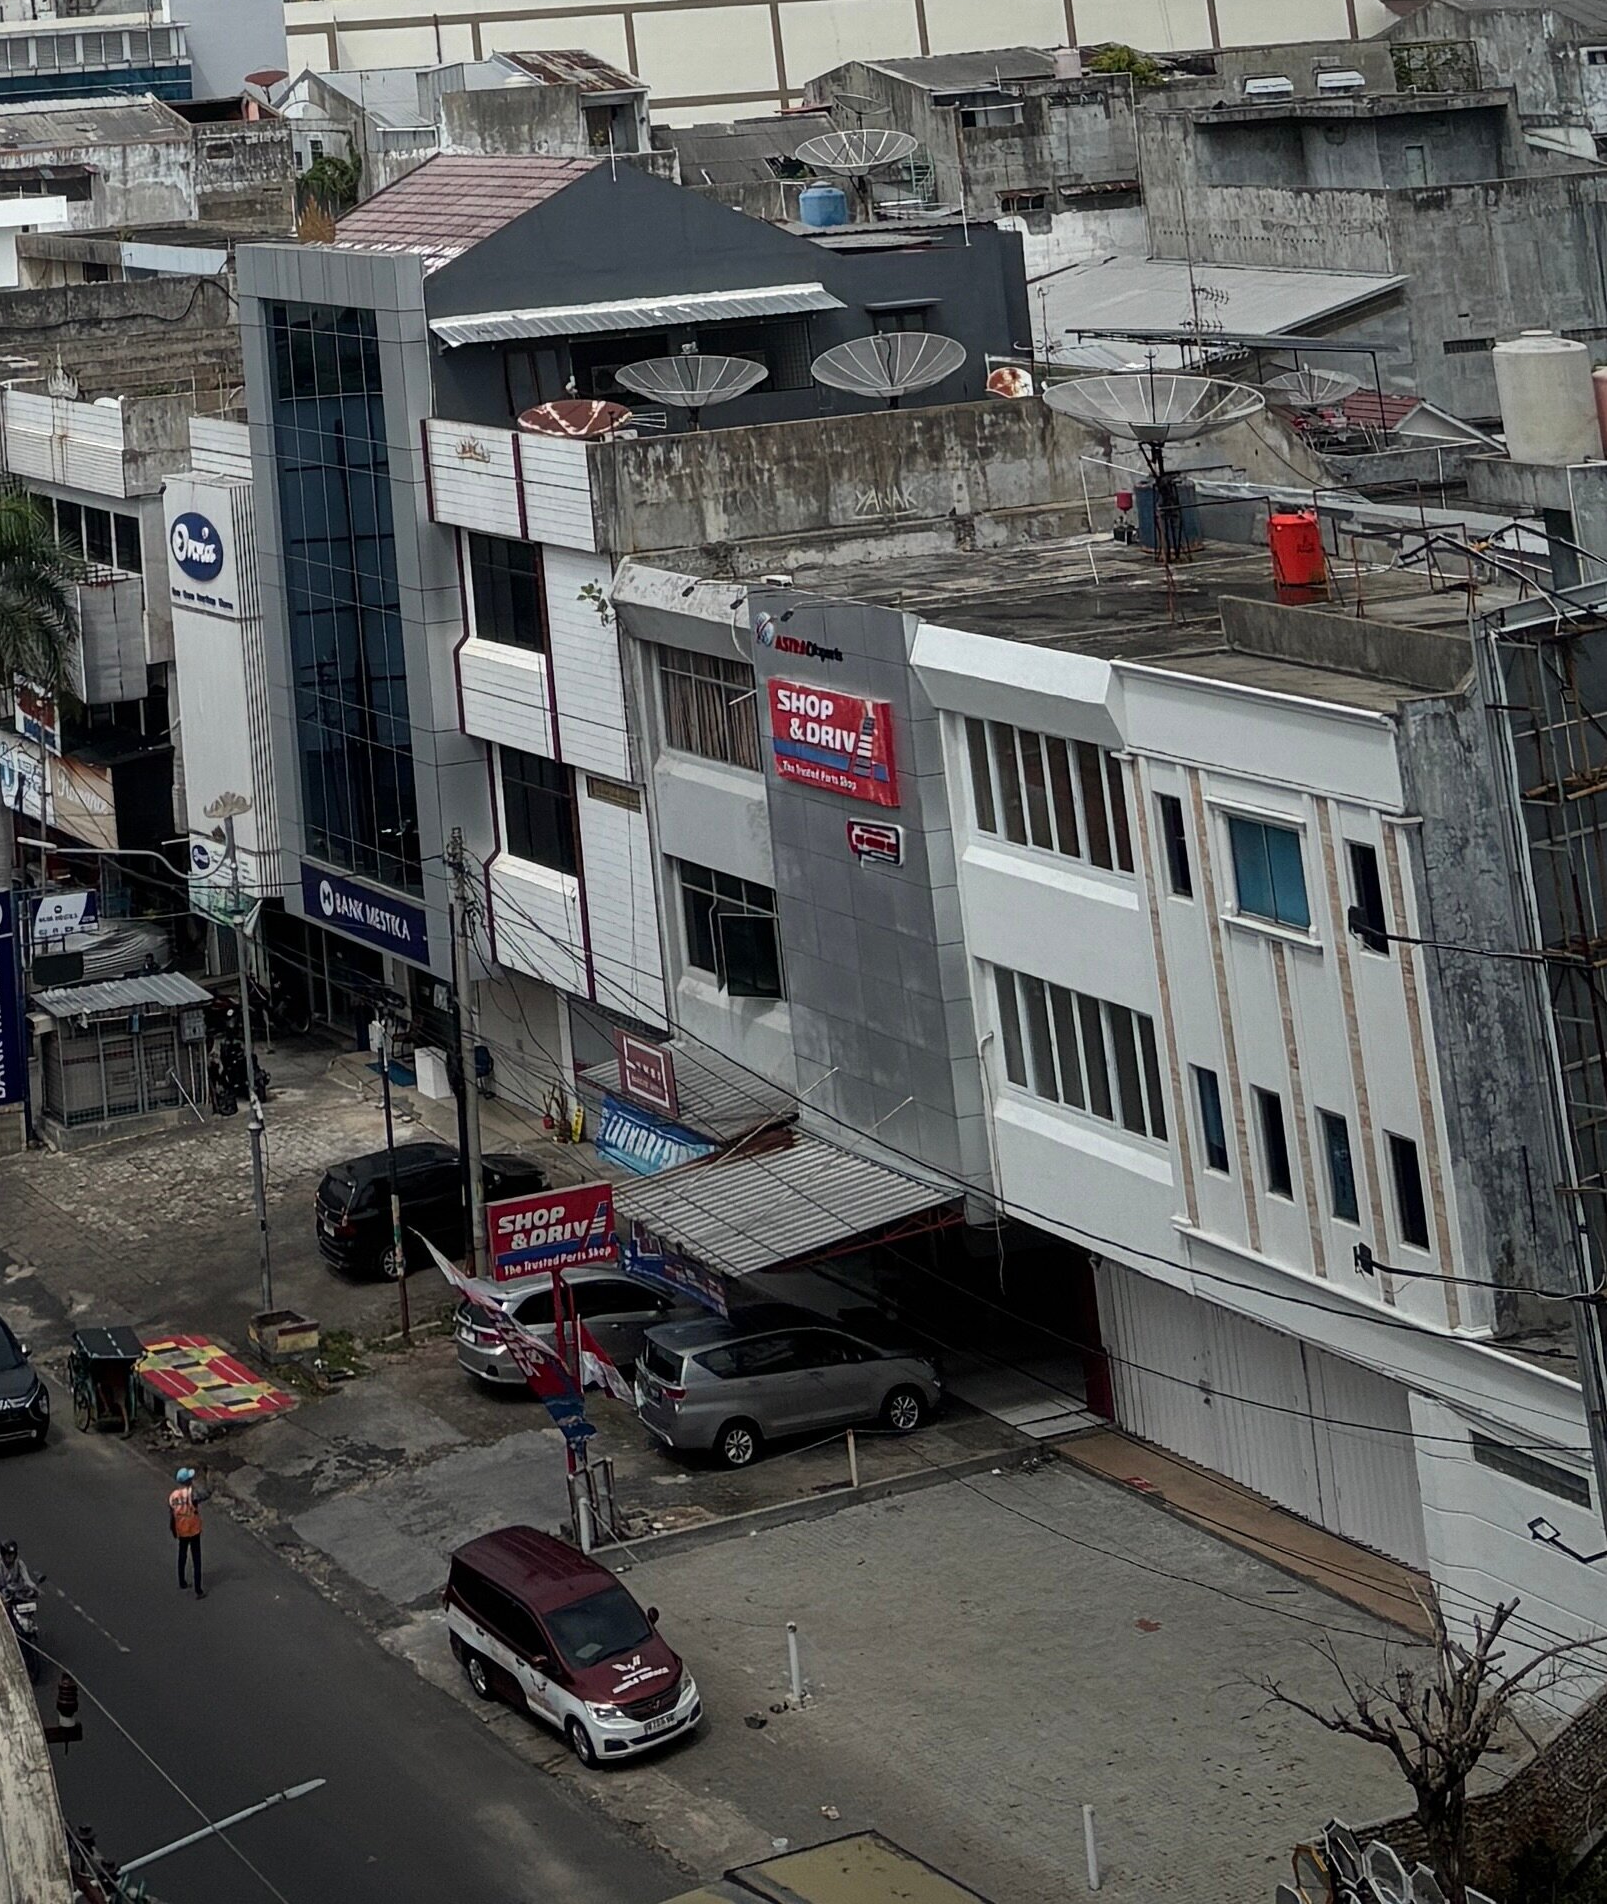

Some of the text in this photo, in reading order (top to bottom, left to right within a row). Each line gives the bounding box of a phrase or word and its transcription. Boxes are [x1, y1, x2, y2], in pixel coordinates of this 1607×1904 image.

[777, 689, 834, 720] SHOP
[334, 892, 364, 923] BANK
[365, 903, 411, 942] MESTIKA
[604, 1114, 663, 1166] LAUNDRY
[497, 1205, 565, 1235] SHOP
[504, 1245, 612, 1276] The Trusted Parts Shop
